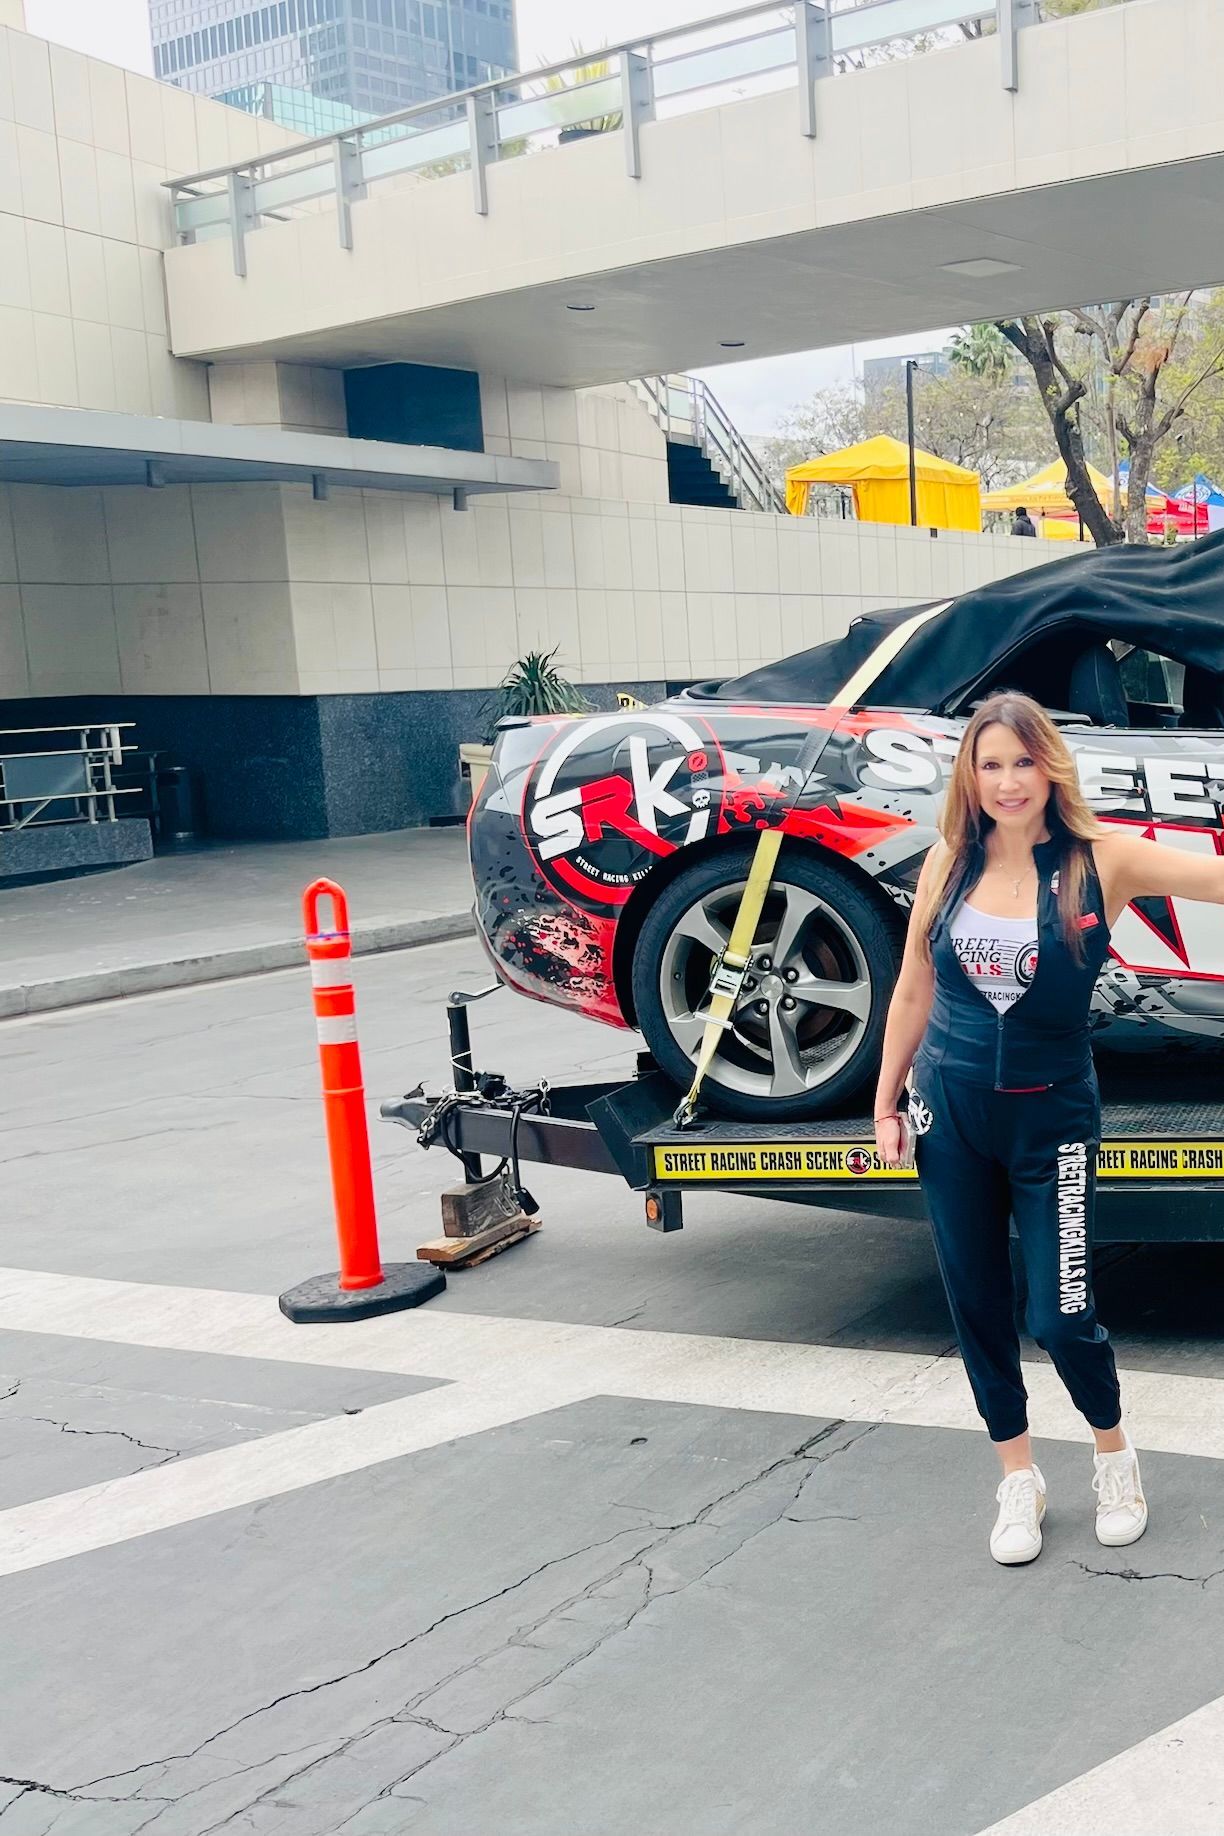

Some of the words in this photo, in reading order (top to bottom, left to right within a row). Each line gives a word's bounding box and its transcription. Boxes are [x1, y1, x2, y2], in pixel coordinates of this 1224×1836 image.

[575, 856, 600, 877] STREET
[603, 872, 629, 883] RACING
[952, 938, 1000, 951] REET
[959, 951, 1002, 963] CING
[664, 1152, 707, 1172] STREET
[711, 1152, 757, 1171] RACING
[760, 1151, 802, 1171] CRASH
[806, 1151, 844, 1170] SCENE
[1098, 1149, 1126, 1169] REET
[1130, 1149, 1178, 1169] RACING
[1182, 1149, 1224, 1169] CRASH
